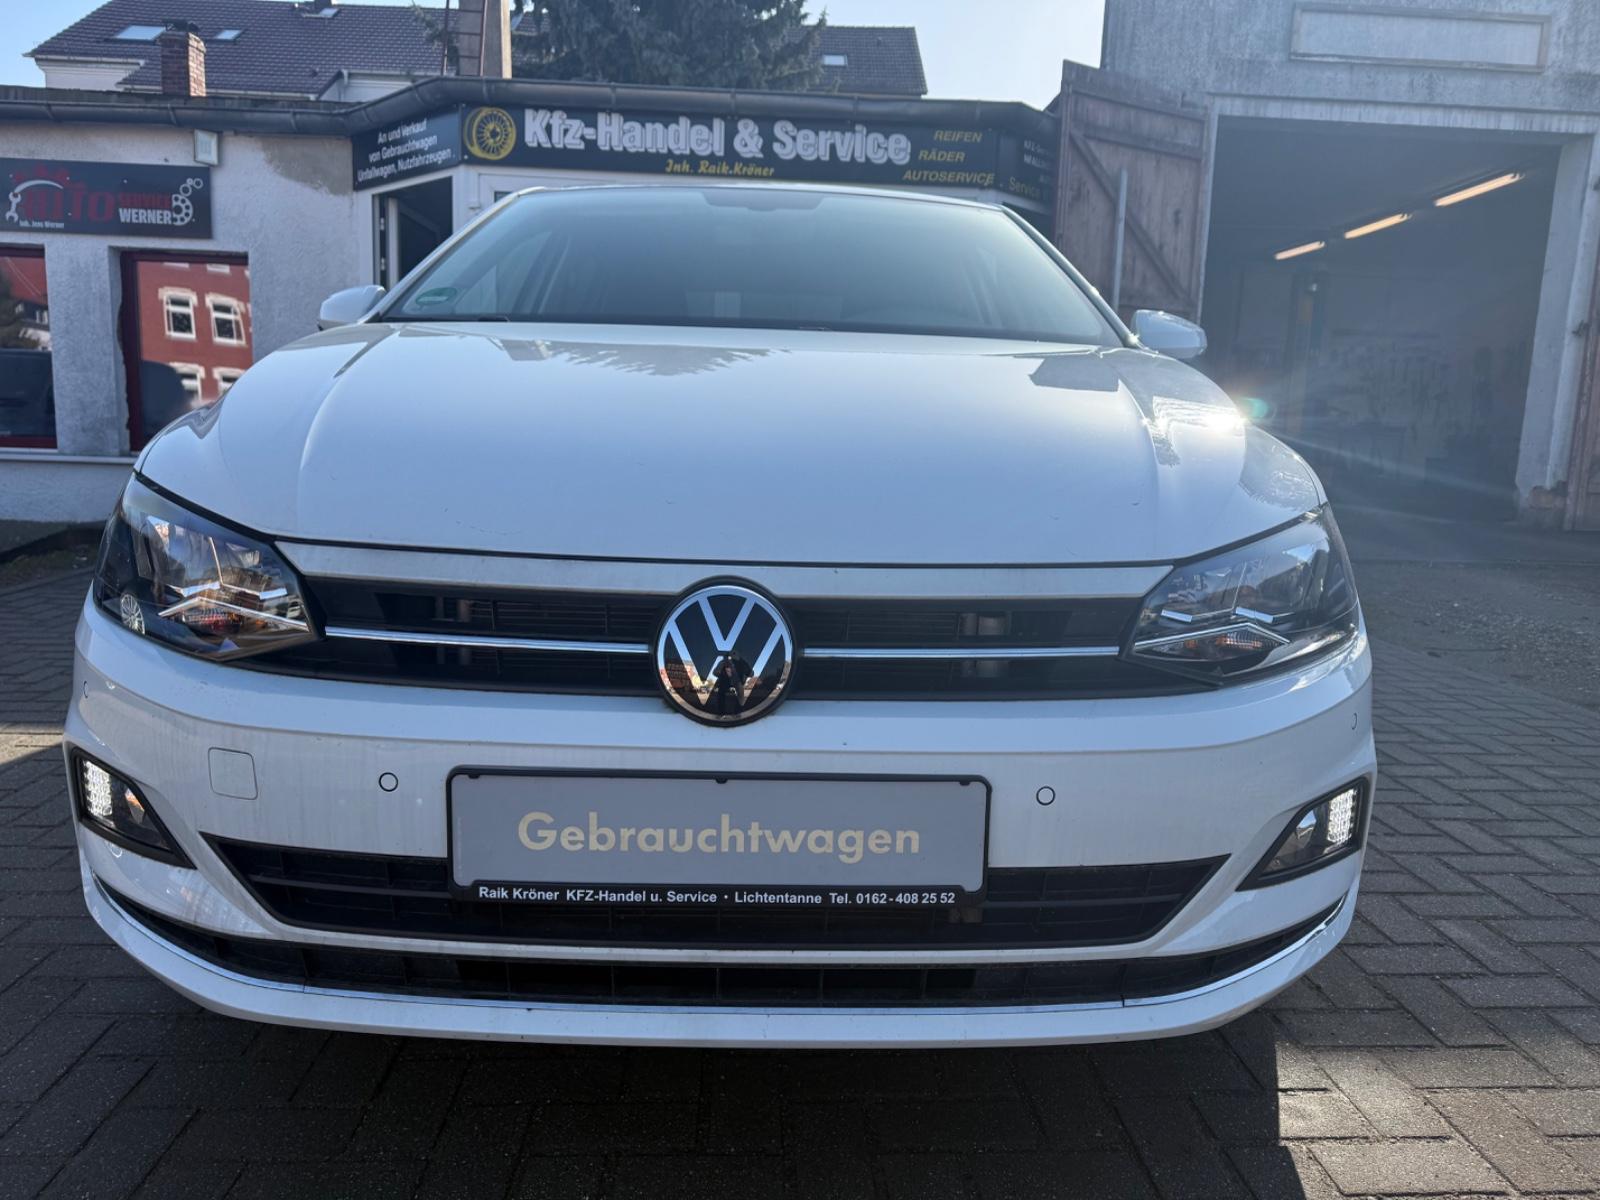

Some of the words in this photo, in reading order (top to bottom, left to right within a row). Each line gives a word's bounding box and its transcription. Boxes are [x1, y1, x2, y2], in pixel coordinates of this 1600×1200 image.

[524, 109, 726, 156] Kfz-Handel
[733, 118, 764, 158] &
[773, 120, 912, 165] Service
[934, 130, 983, 143] REIFEN
[918, 149, 966, 163] RÄDER
[902, 170, 995, 186] AUTOSERVICE
[118, 207, 173, 225] WERNER
[518, 811, 921, 864] Gebrauchtwagen
[478, 886, 509, 900] Raik
[512, 888, 560, 901] Kröner
[566, 889, 647, 903] KFZ-Handel
[650, 891, 663, 903] u.
[666, 890, 718, 903] Service
[734, 891, 823, 904] Lichtentanne
[829, 892, 852, 905] Tel.
